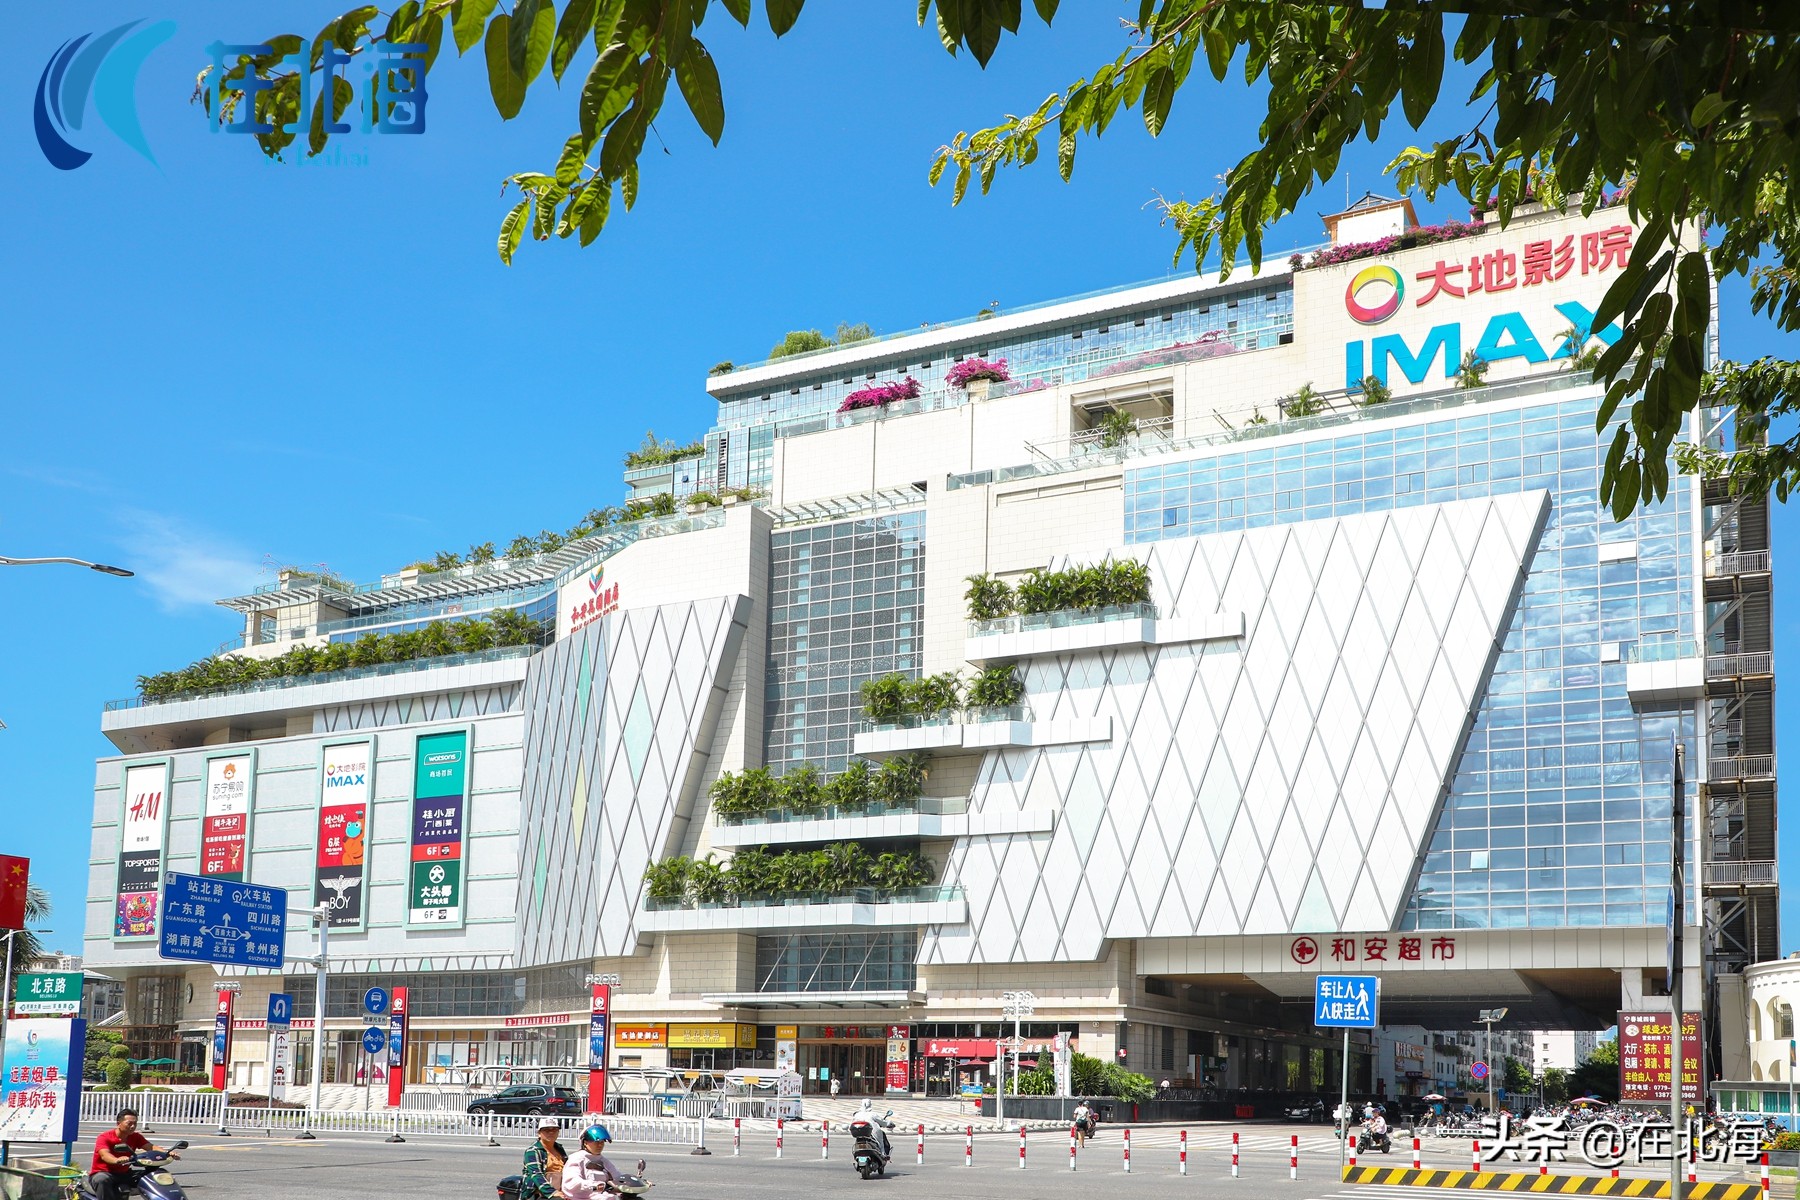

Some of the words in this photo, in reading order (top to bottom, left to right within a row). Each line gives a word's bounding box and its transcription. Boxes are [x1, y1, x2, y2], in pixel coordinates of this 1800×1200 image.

[1416, 224, 1633, 307] 大地影院
[1346, 301, 1626, 395] IMAX
[336, 762, 366, 773] 大地影院
[213, 781, 244, 794] 苏宁易购
[327, 774, 364, 788] IMAX
[129, 792, 161, 822] H&M
[427, 846, 437, 856] 6F
[125, 858, 159, 867] TOPSPORTS
[208, 860, 221, 872] 6F
[188, 881, 224, 896] 站北路
[243, 888, 271, 903] 火车站
[168, 901, 206, 917] 广东路
[241, 901, 257, 909] RAILWAY
[330, 896, 351, 910] BOY
[165, 915, 197, 924] GUANGDONG
[247, 911, 281, 926] 四川路
[424, 911, 434, 919] 6F
[215, 928, 236, 938] 西南大道
[250, 925, 271, 933] SICHUAN
[166, 933, 204, 948] 湖南路
[213, 945, 236, 954] 北京路
[246, 941, 279, 956] 贵州路
[1331, 936, 1455, 961] 和安超市
[31, 977, 66, 994] 北京路
[1320, 981, 1356, 999] 车让人
[1320, 1002, 1356, 1020] 人快走
[825, 1026, 858, 1038] 东门
[1624, 1043, 1672, 1055] 大厅：茶市、酒
[10, 1066, 59, 1083] 远离烟草
[7, 1091, 57, 1109] 健康你我
